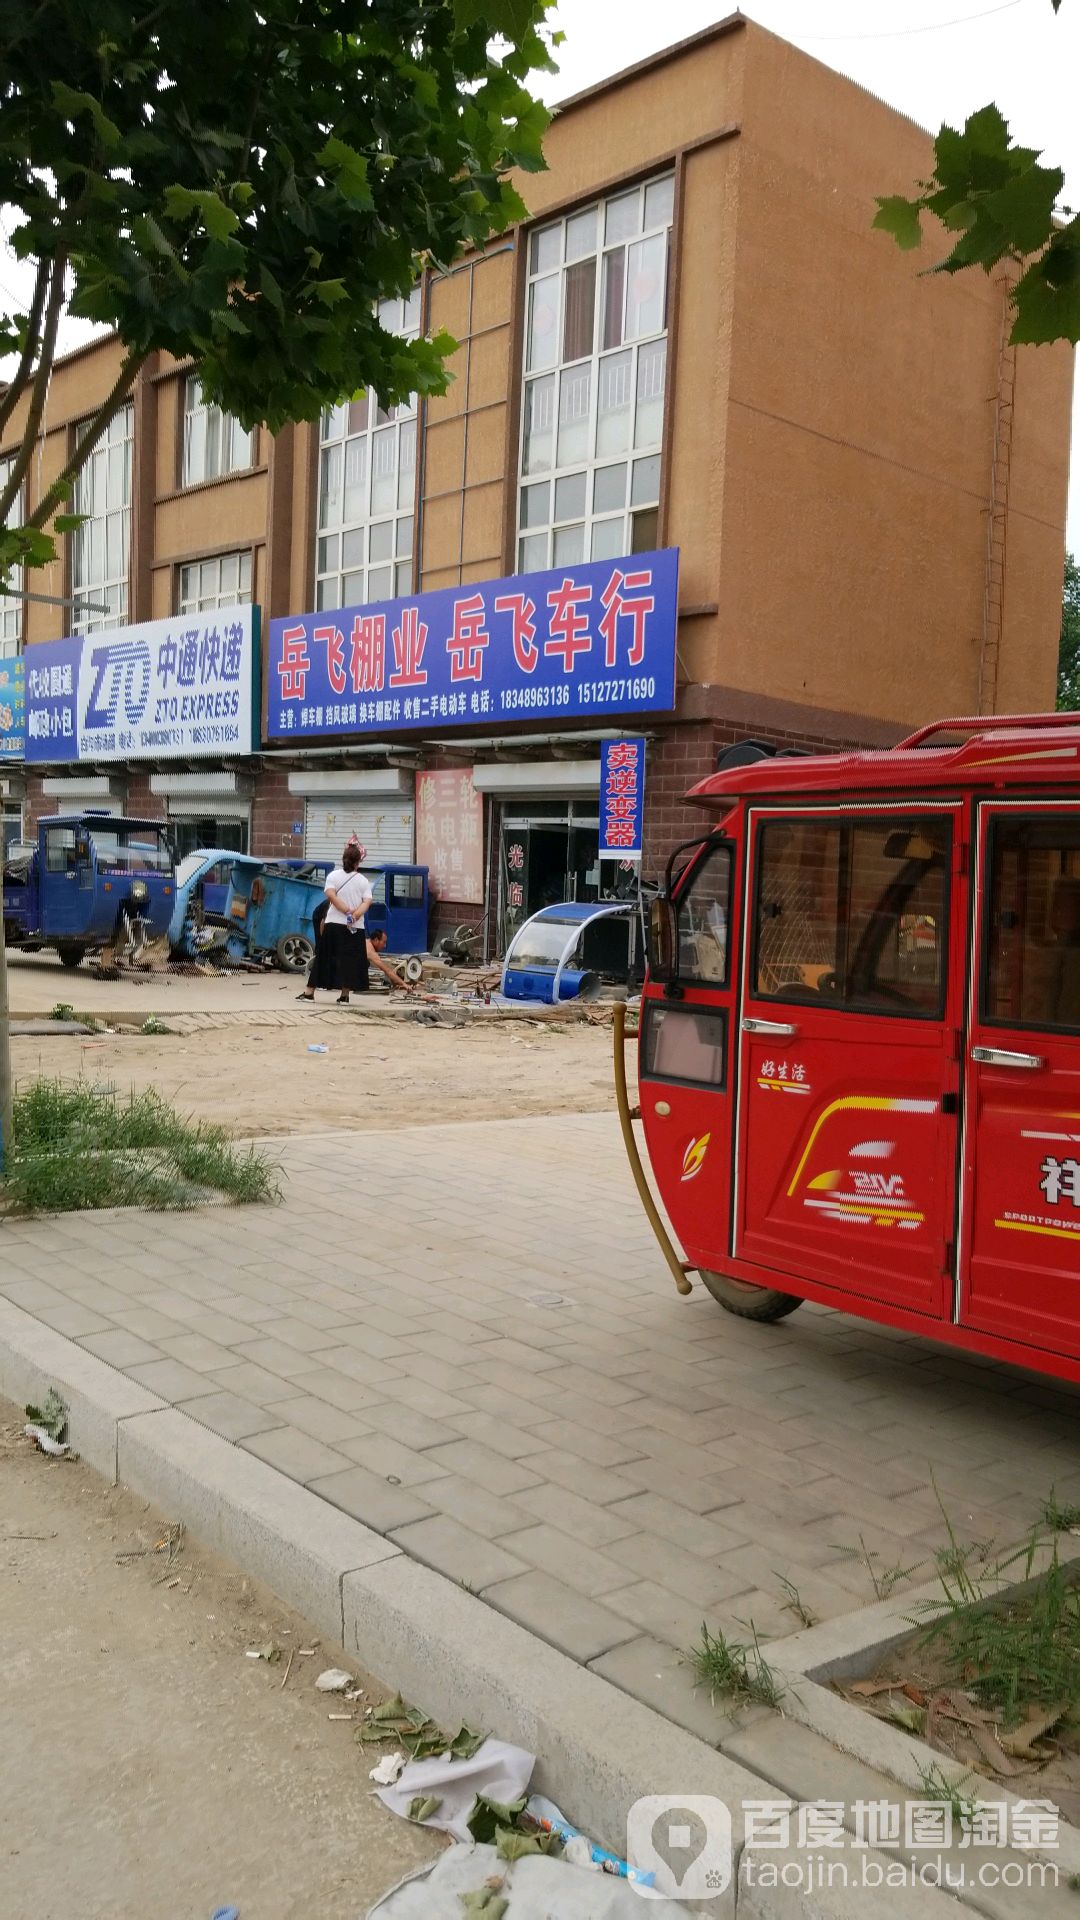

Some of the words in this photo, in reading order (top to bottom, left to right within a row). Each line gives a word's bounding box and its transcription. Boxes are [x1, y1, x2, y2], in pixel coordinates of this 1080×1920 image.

[156, 621, 243, 689] 中通快递
[277, 607, 428, 701] 岳飞棚业
[446, 568, 654, 682] 岳飞车行
[155, 697, 178, 724] ZTO
[181, 689, 240, 721] EXPRESS
[326, 703, 357, 726] 挡风玻璃
[360, 699, 400, 724] 换车棚配件
[404, 692, 467, 720] 收售二手电动车
[471, 689, 494, 713] 电话：
[500, 685, 570, 710] 18348963136
[577, 677, 656, 703] 15127271690
[604, 743, 638, 848] 卖逆变器
[435, 847, 464, 871] 收售
[508, 844, 524, 907] 光临
[761, 1060, 806, 1081] 好生活
